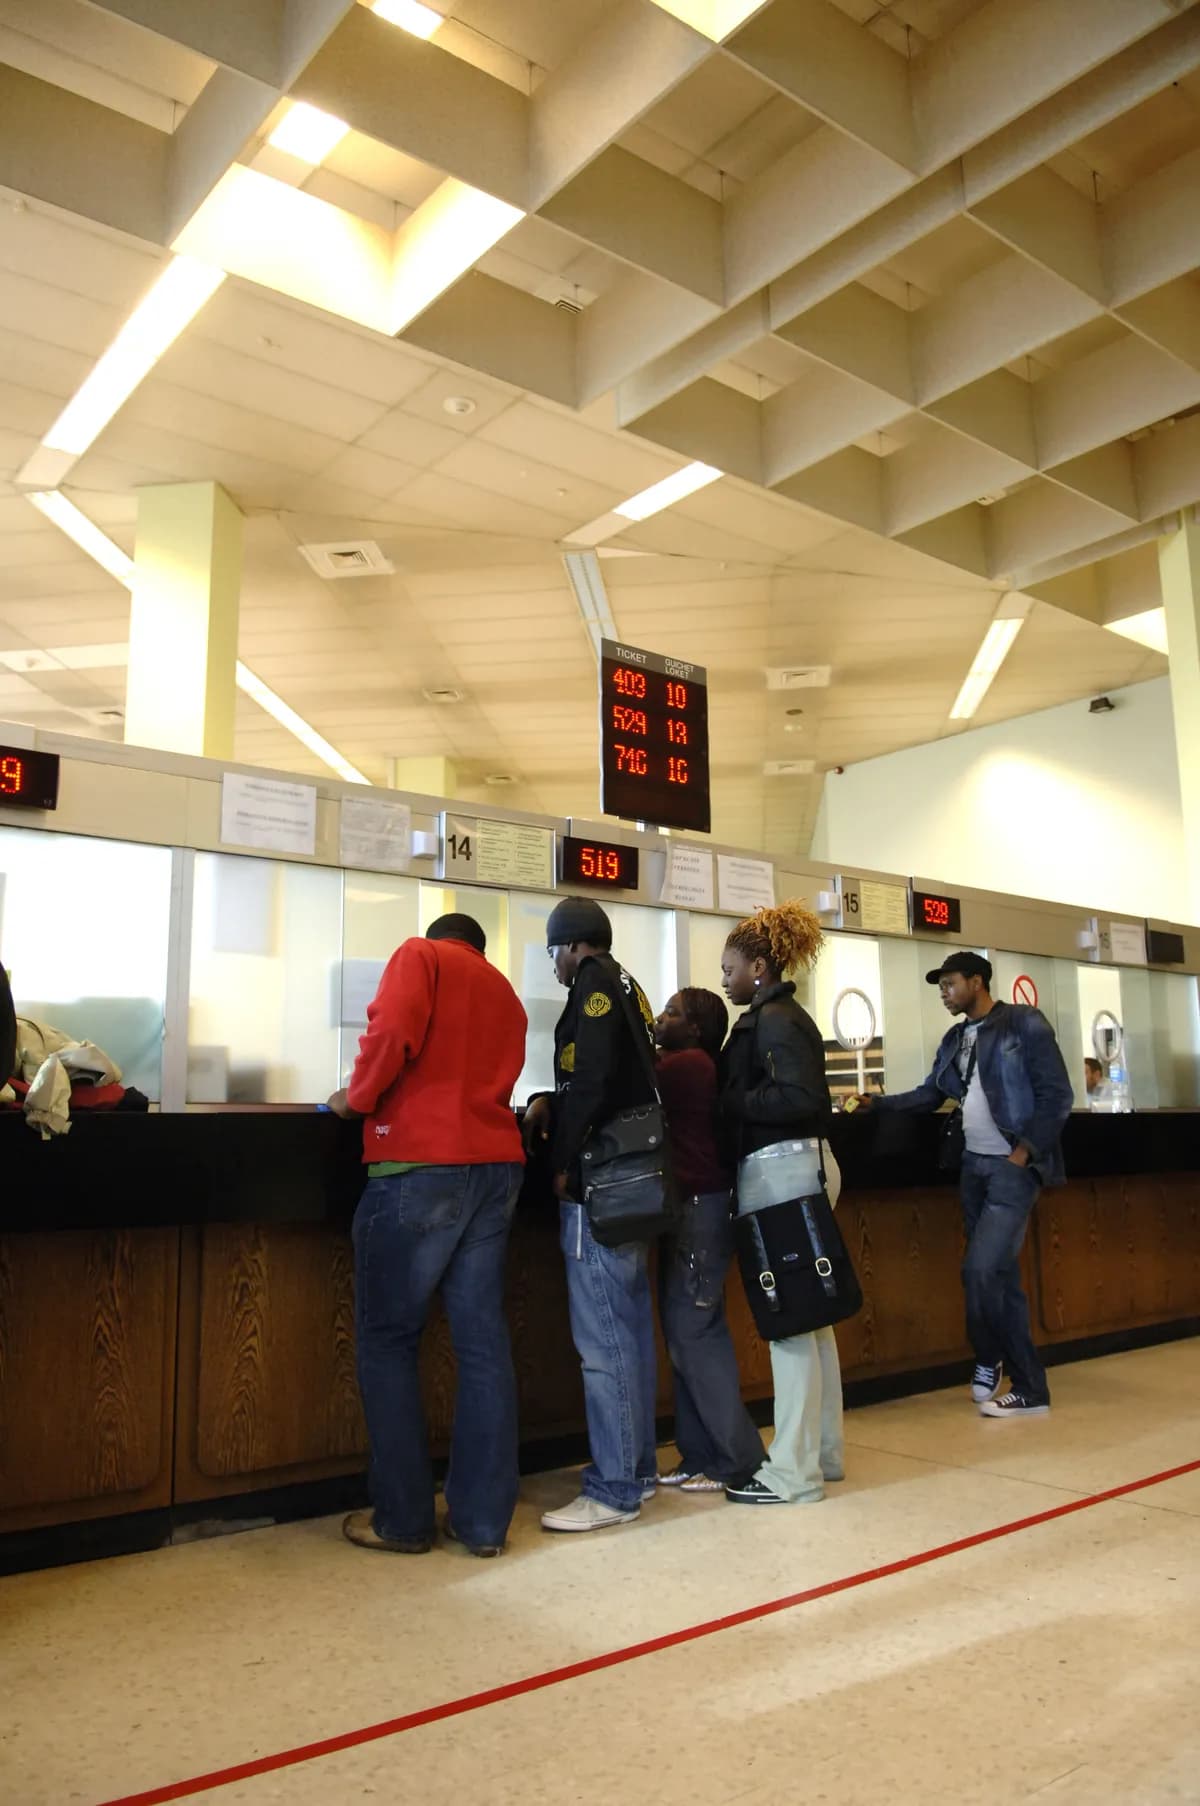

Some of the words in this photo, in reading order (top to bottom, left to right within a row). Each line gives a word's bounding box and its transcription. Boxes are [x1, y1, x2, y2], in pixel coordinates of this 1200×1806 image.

[616, 647, 647, 664] TICKET
[665, 658, 695, 673] GUICHET
[665, 666, 689, 680] LOKET
[613, 668, 646, 699] 403
[666, 682, 686, 709] 10
[613, 705, 647, 735] 529
[667, 719, 687, 745] 13
[1, 757, 21, 794] 9
[447, 834, 472, 861] 14
[581, 848, 618, 879] 519
[843, 892, 859, 914] 15
[924, 899, 949, 925] 528
